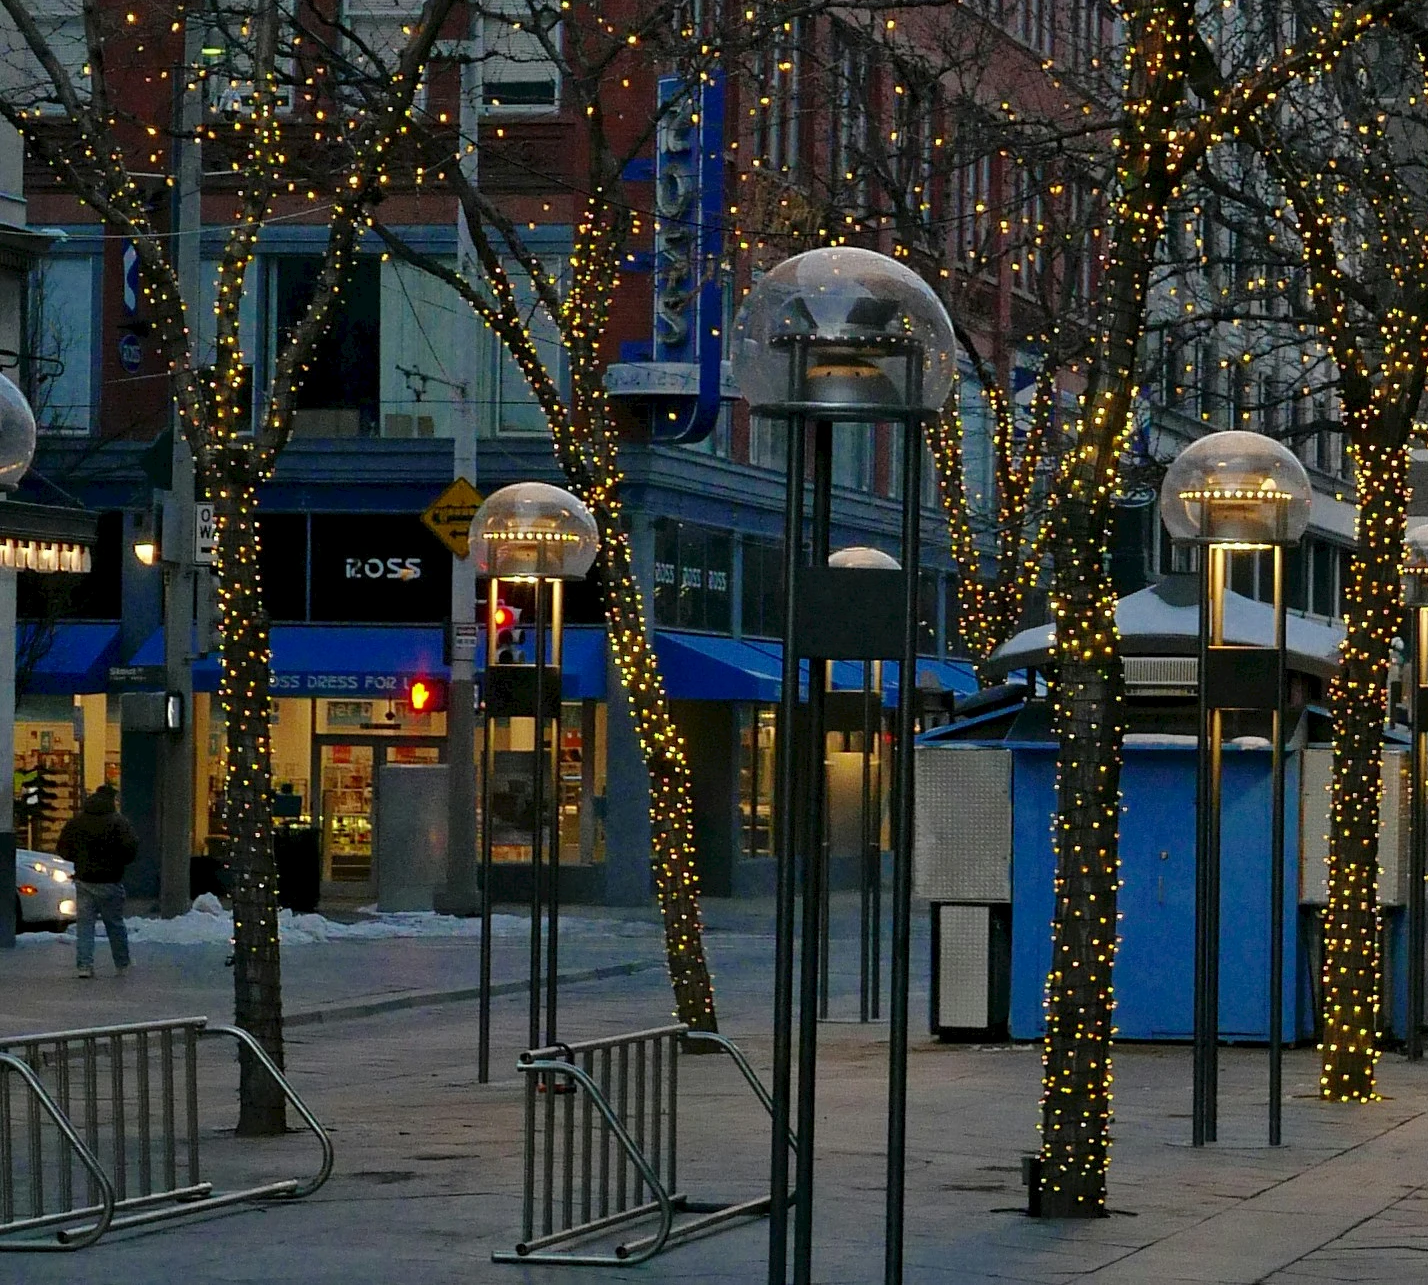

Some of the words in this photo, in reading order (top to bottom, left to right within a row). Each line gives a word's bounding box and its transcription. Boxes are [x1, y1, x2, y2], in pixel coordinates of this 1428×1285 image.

[346, 558, 422, 579] ROSS
[269, 675, 300, 689] OSS
[307, 675, 358, 689] DRESS
[364, 675, 397, 689] FOR
